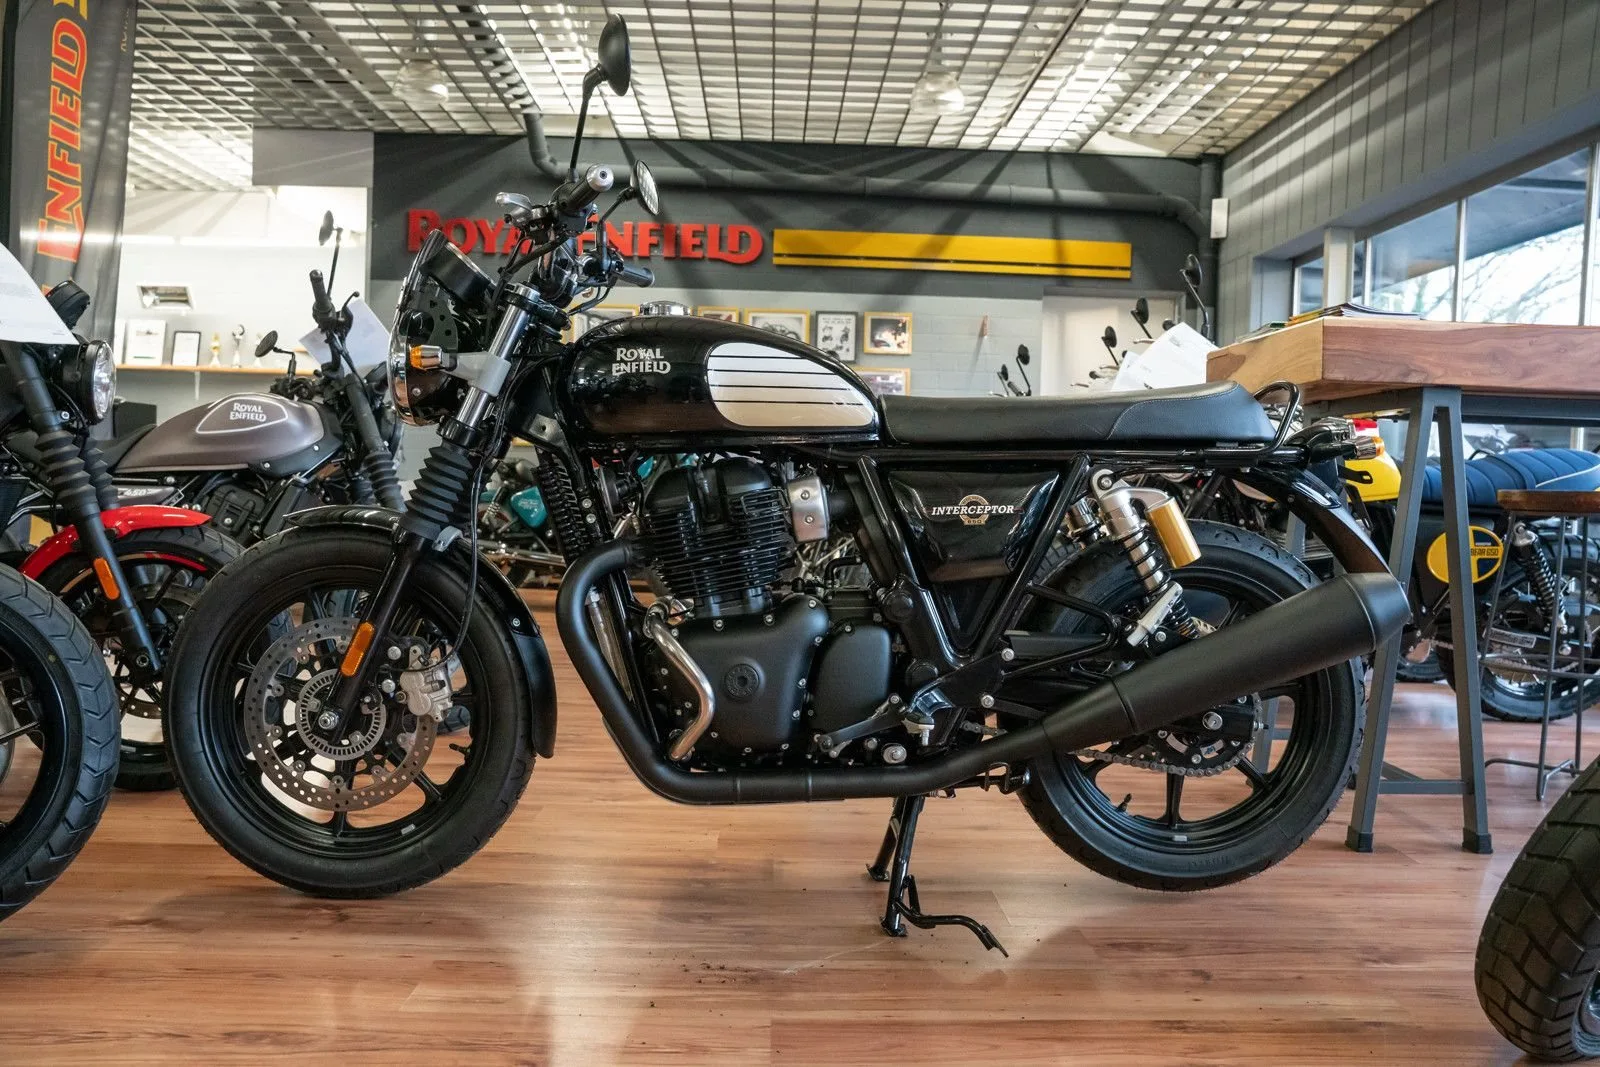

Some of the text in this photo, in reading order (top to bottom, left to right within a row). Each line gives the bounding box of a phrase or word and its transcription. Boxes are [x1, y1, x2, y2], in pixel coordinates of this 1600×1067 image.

[36, 18, 88, 263] ENFIELD
[407, 208, 540, 257] ROYA
[616, 347, 665, 361] ROYAL
[612, 360, 671, 376] ENFIELD
[233, 402, 264, 413] ROYAL
[229, 411, 267, 422] ENFIELD
[931, 505, 1015, 516] INTERCEPTOR
